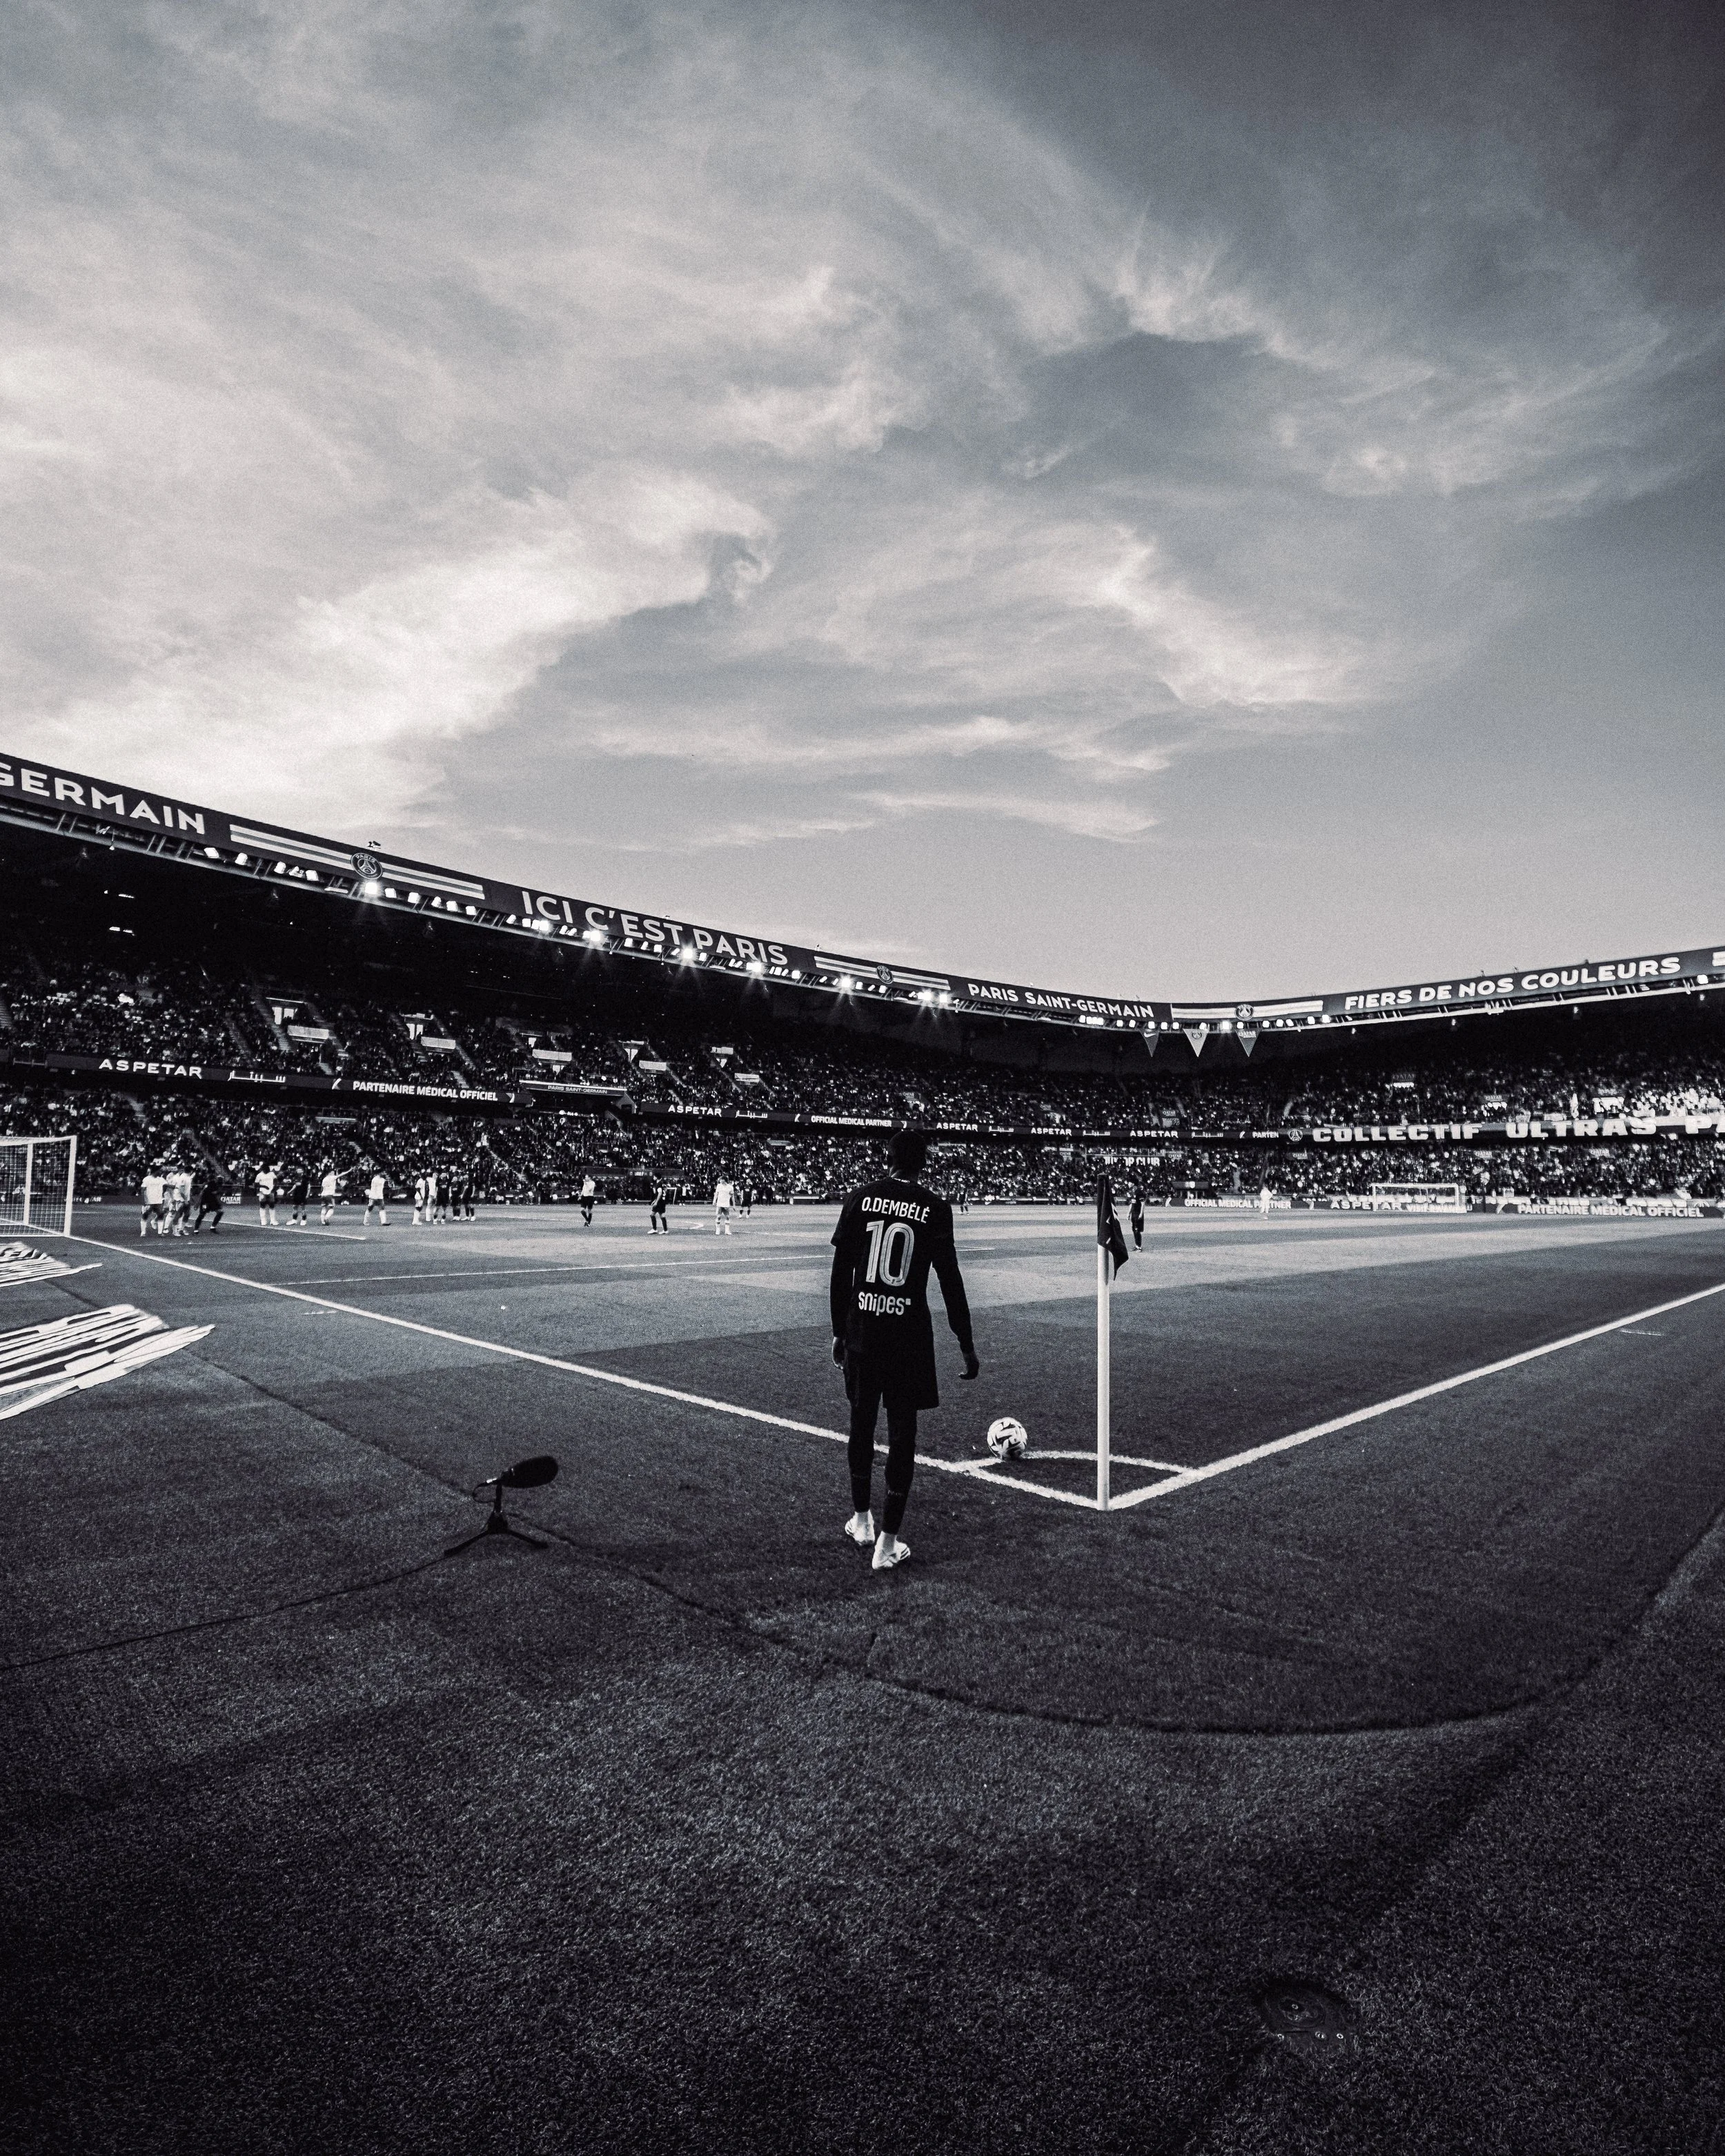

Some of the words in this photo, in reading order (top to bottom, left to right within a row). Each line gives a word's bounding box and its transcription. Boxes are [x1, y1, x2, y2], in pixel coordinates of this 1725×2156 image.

[522, 891, 573, 924] ICI
[585, 907, 682, 946] C'EST
[693, 929, 788, 965] PARIS
[1344, 989, 1412, 1010] FIERS
[1419, 985, 1452, 1002] DE
[1459, 977, 1514, 998] NOS
[1521, 957, 1681, 990] COULEURS
[967, 983, 1018, 1002] PARIS
[1025, 991, 1154, 1018] SAINT-GERMAIN
[99, 1058, 202, 1080] ASPETAR
[353, 1080, 415, 1095] PARTENAIRE
[417, 1086, 458, 1098] MÉDICAL
[460, 1089, 498, 1101] OFFICIEL
[668, 1105, 722, 1117] ASPETAR
[811, 1115, 838, 1125] OFFICIAL
[838, 1117, 865, 1126] MEDICAL
[865, 1118, 892, 1127] PARTNER
[936, 1122, 978, 1132] ASPETAR
[1312, 1122, 1483, 1143] COLLECTIF
[1505, 1116, 1657, 1138] ULTRAS
[1031, 1127, 1072, 1136] ASPETAR
[1130, 1130, 1179, 1138] ASPETAR
[862, 1196, 930, 1224] O.DEMBÉLÉ
[1184, 1198, 1218, 1207] OFFICIAL
[1253, 1200, 1292, 1209] PTNER
[1330, 1201, 1403, 1211] ASPETAR
[1517, 1205, 1590, 1215] PARTENAIRE
[1648, 1207, 1704, 1218] OFFICIEL
[865, 1220, 915, 1287] 10
